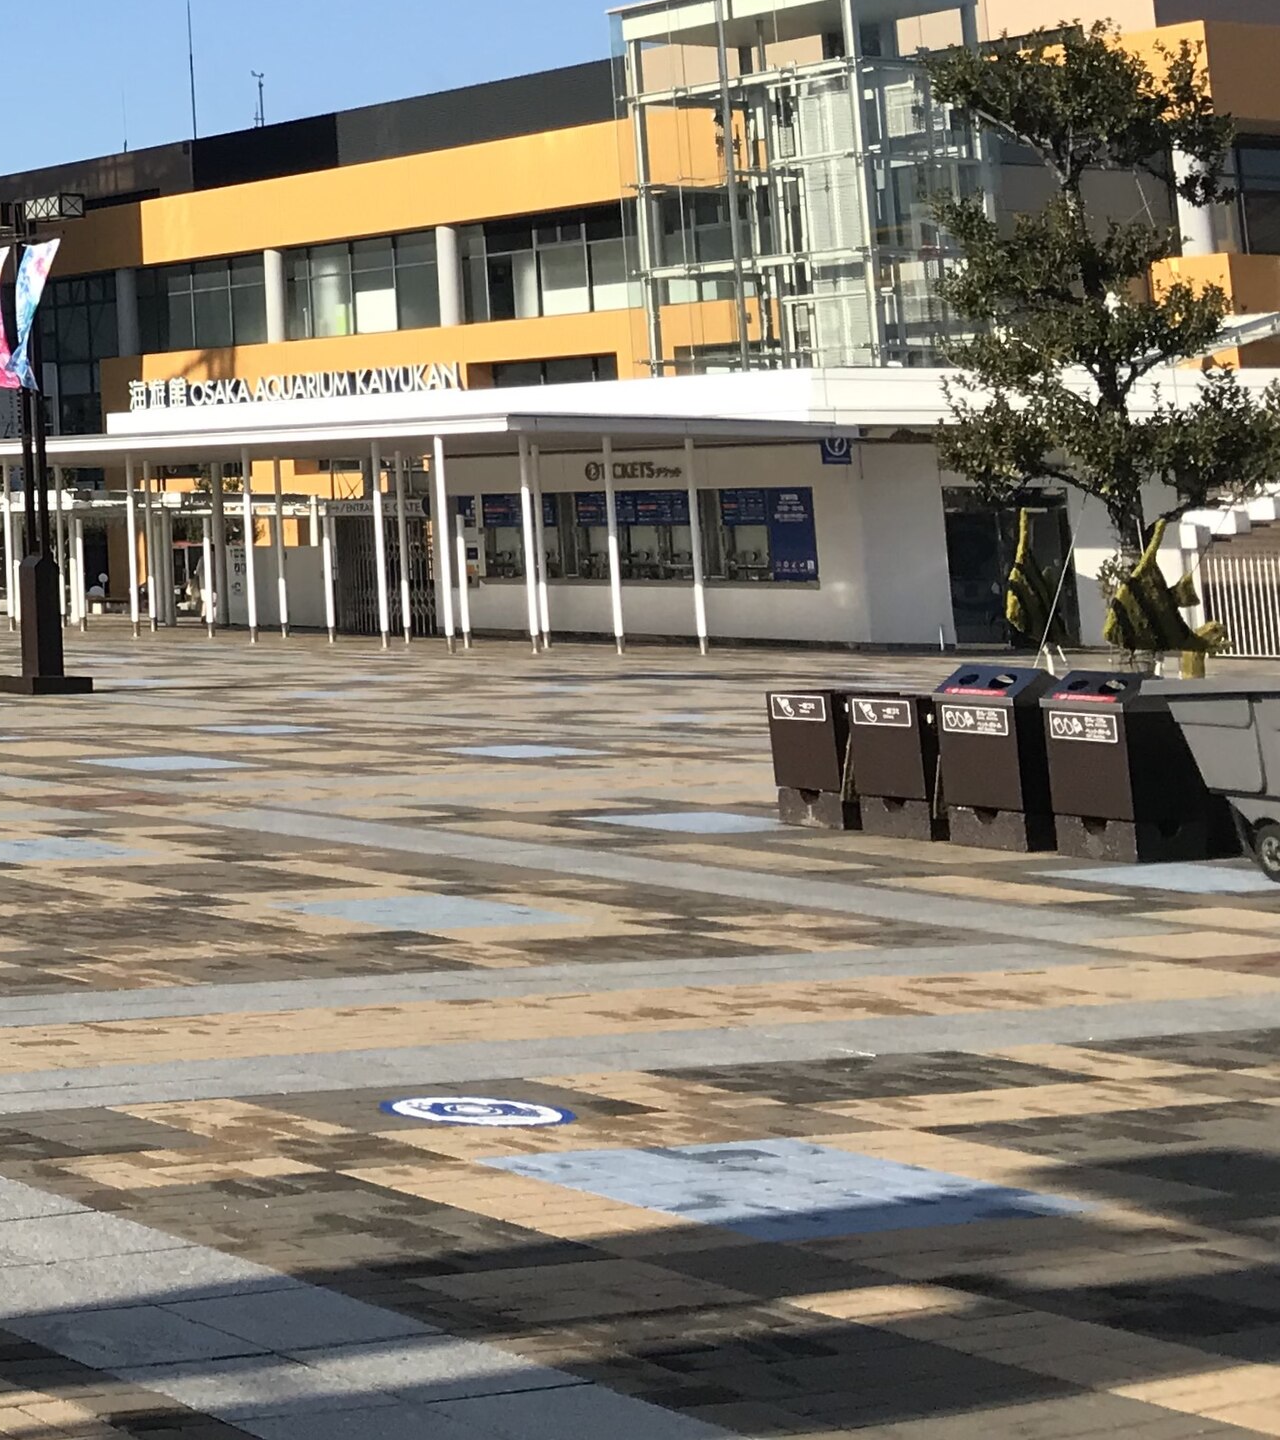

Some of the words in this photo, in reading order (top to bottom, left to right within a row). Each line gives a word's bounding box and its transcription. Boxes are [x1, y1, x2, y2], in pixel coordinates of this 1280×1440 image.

[128, 376, 187, 410] 海遊館
[190, 377, 251, 406] OSAKA
[254, 371, 351, 401] AQUARIUM
[355, 362, 460, 395] KAIYUKAN
